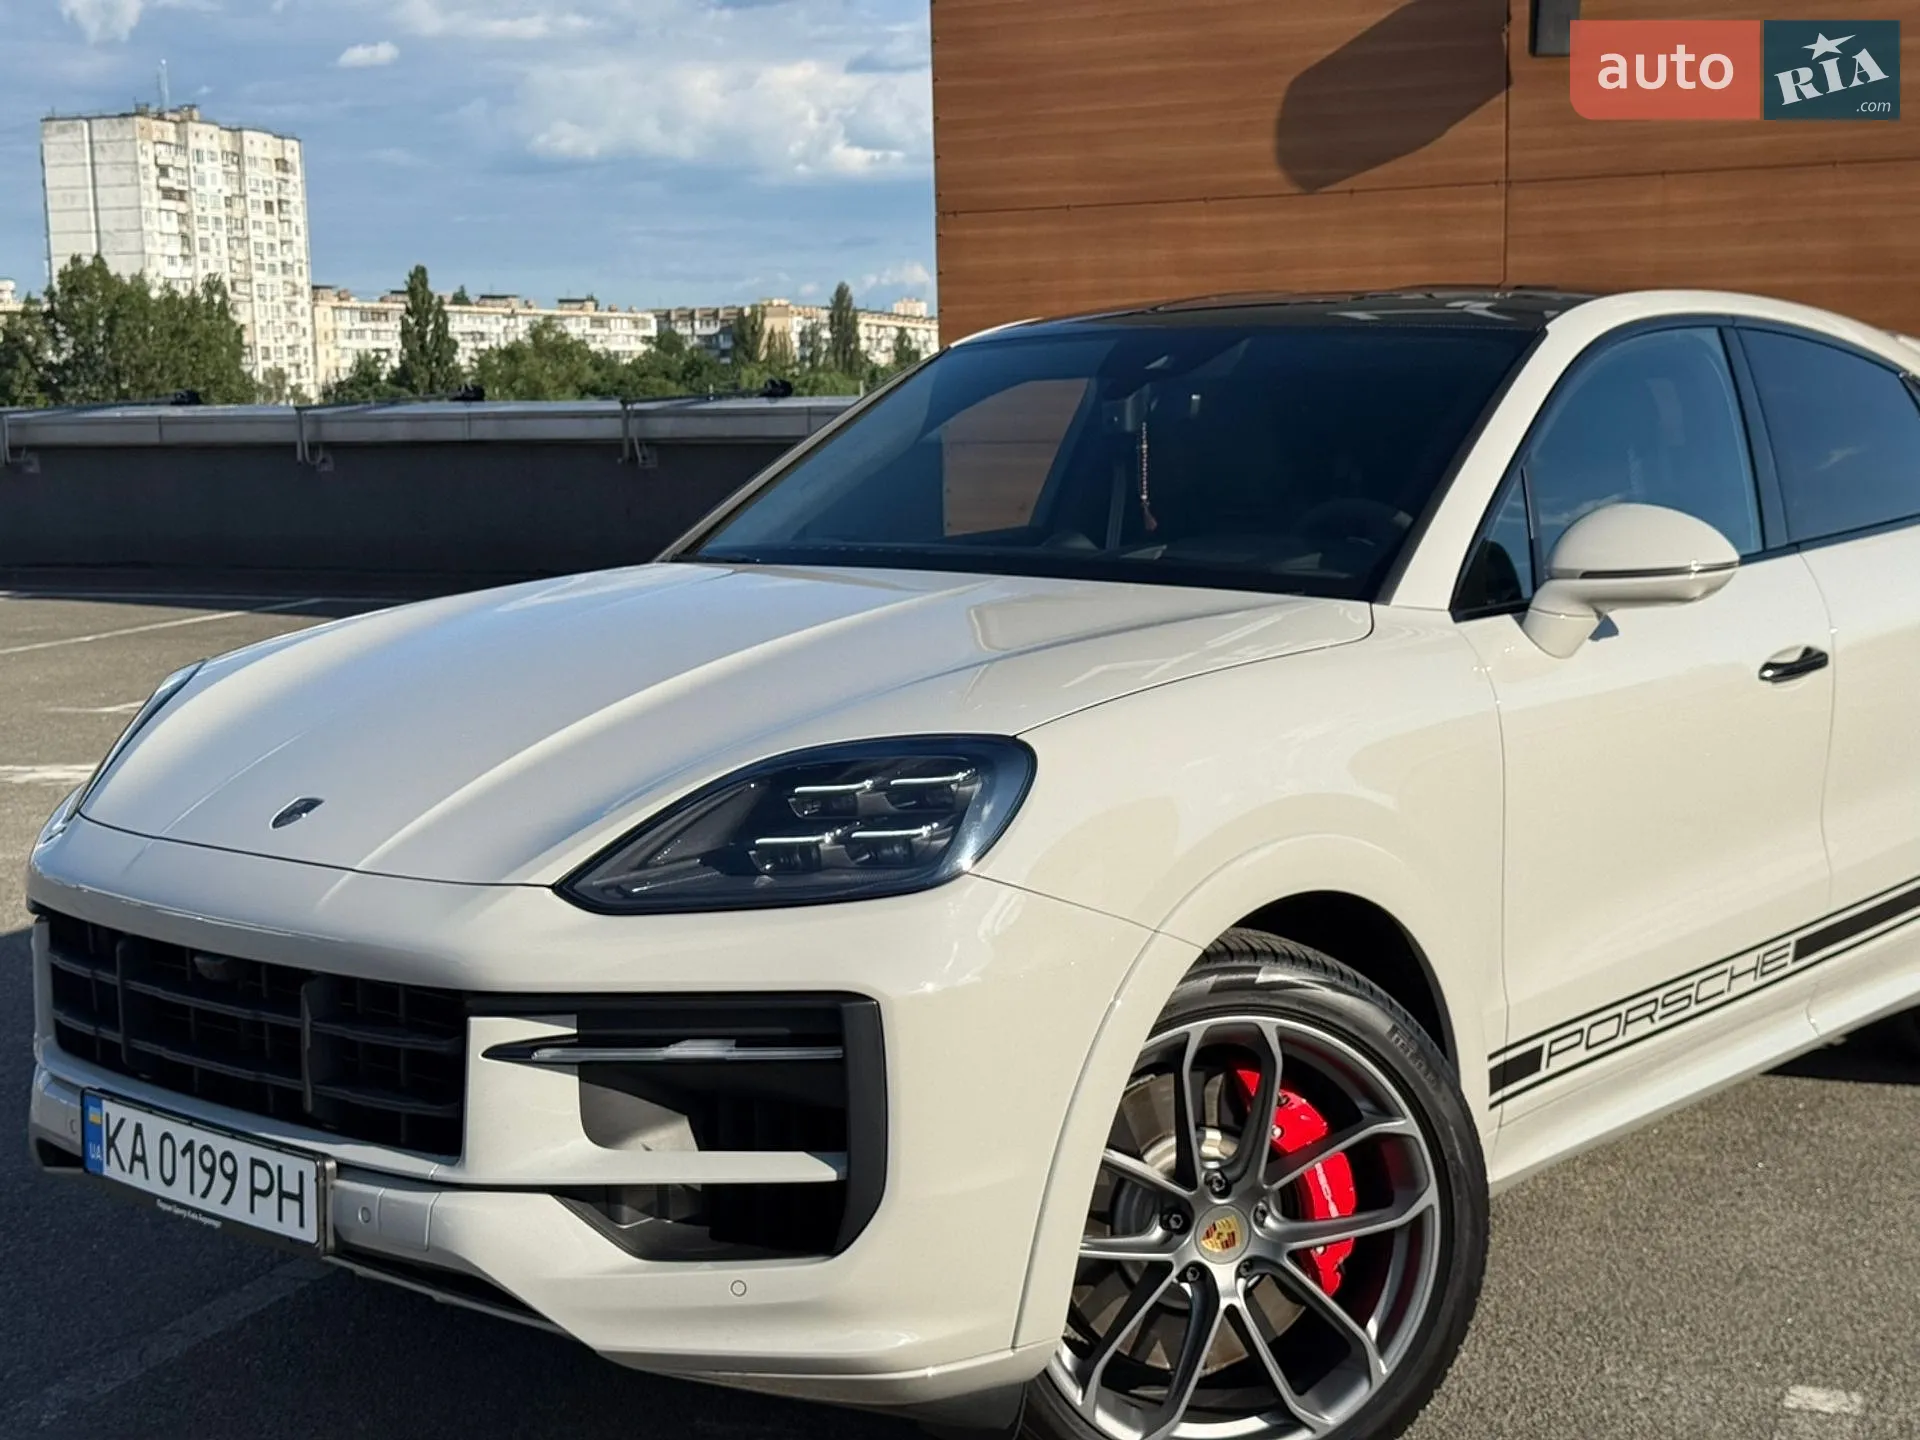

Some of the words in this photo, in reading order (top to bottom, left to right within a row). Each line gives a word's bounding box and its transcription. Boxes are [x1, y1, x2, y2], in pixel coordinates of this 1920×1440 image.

[1545, 941, 1792, 1069] PORSCHE
[89, 1143, 103, 1161] UA
[105, 1112, 149, 1181] KA
[159, 1131, 238, 1206] 0199
[250, 1156, 305, 1228] PH
